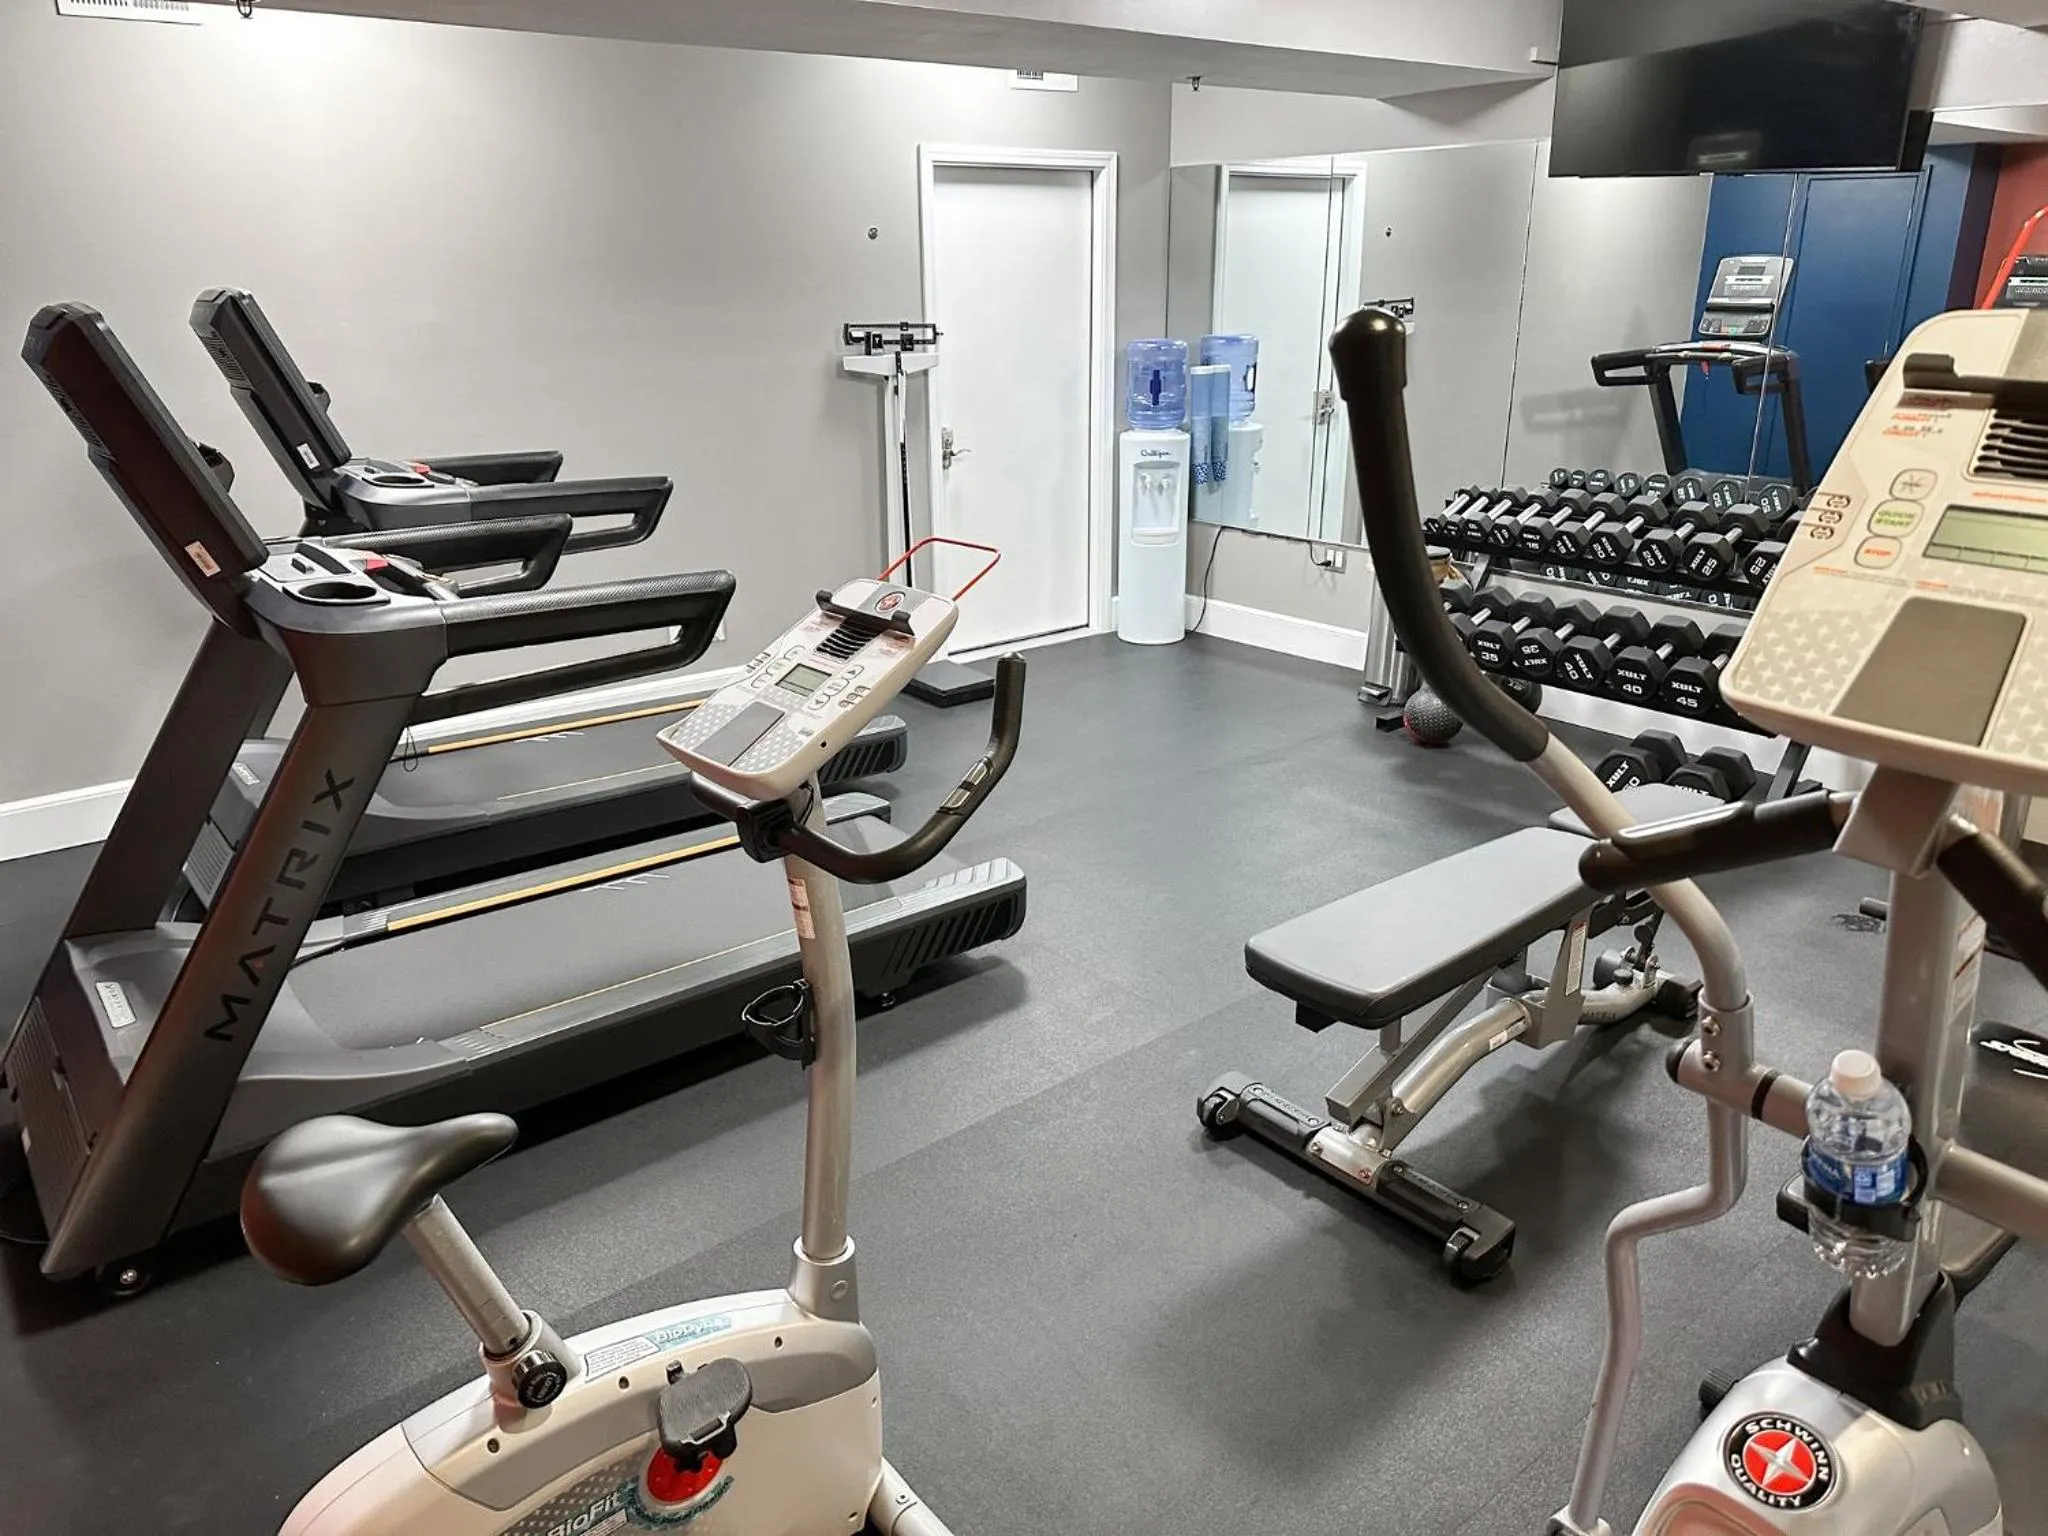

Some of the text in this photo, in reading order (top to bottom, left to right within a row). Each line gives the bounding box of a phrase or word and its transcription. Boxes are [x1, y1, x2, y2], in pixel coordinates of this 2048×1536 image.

[1600, 536, 1617, 558] XULT
[1650, 543, 1667, 566] XULT
[1642, 550, 1656, 567] 20
[1690, 547, 1706, 570] XULT
[1702, 558, 1718, 577] 25
[1750, 556, 1767, 575] 25
[1477, 639, 1501, 650] XULT
[1521, 645, 1540, 655] 35
[1481, 652, 1499, 662] 35
[1524, 657, 1548, 666] XULT
[1564, 662, 1579, 680] 40
[1574, 653, 1594, 680] XULT
[1616, 668, 1647, 681] XULT
[1622, 683, 1643, 695] 40
[1671, 681, 1703, 693] XULT
[1676, 696, 1698, 708] 45
[1606, 760, 1630, 788] XULT
[203, 768, 356, 1042] MATRIX
[1744, 1418, 1830, 1482] SCHWINN
[1730, 1453, 1802, 1508] QUALITY
